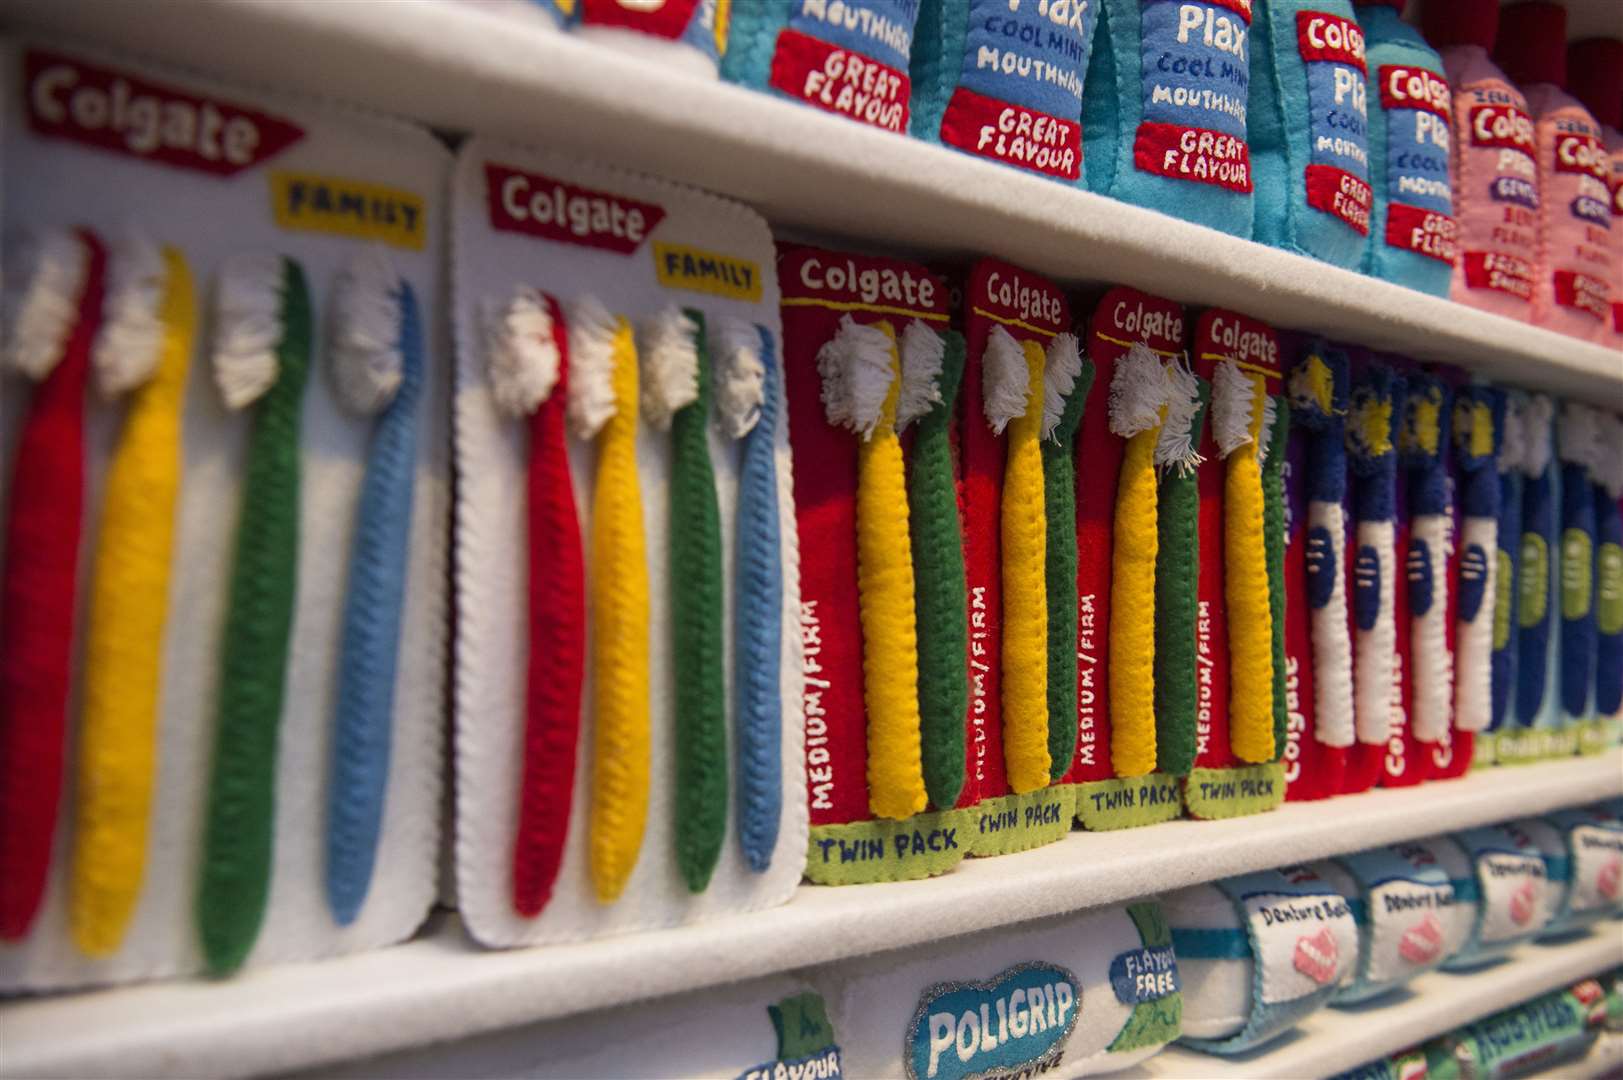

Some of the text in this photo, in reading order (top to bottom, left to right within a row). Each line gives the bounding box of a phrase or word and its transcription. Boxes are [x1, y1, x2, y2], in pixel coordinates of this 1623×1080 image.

[985, 16, 1084, 63] COOL MINT
[1176, 4, 1245, 62] Plax
[824, 50, 901, 100] GREAT
[1157, 52, 1214, 77] COOL
[33, 63, 261, 164] Colgate
[999, 107, 1070, 146] GREAT
[978, 126, 1075, 175] FLAVOUR
[1164, 149, 1248, 186] FLAVOUR
[1181, 131, 1244, 161] GREAT
[502, 176, 645, 240] Colgate
[665, 252, 754, 290] FAMILY
[800, 259, 935, 308] Colgate
[987, 271, 1062, 325] Colgate
[1114, 301, 1184, 343] Colgate
[1210, 318, 1278, 363] Colgate
[1079, 593, 1098, 765] MEDIUM/FIRM
[1197, 600, 1214, 754] MEDIUM/FIRM
[1091, 784, 1178, 812] TWIN PACK
[1200, 780, 1274, 801] TWIN PACK
[979, 801, 1062, 834] TWIN PACK
[816, 827, 959, 865] TWIN PACK
[1259, 902, 1323, 926] Denture
[926, 982, 1074, 1079] POLIGRIP
